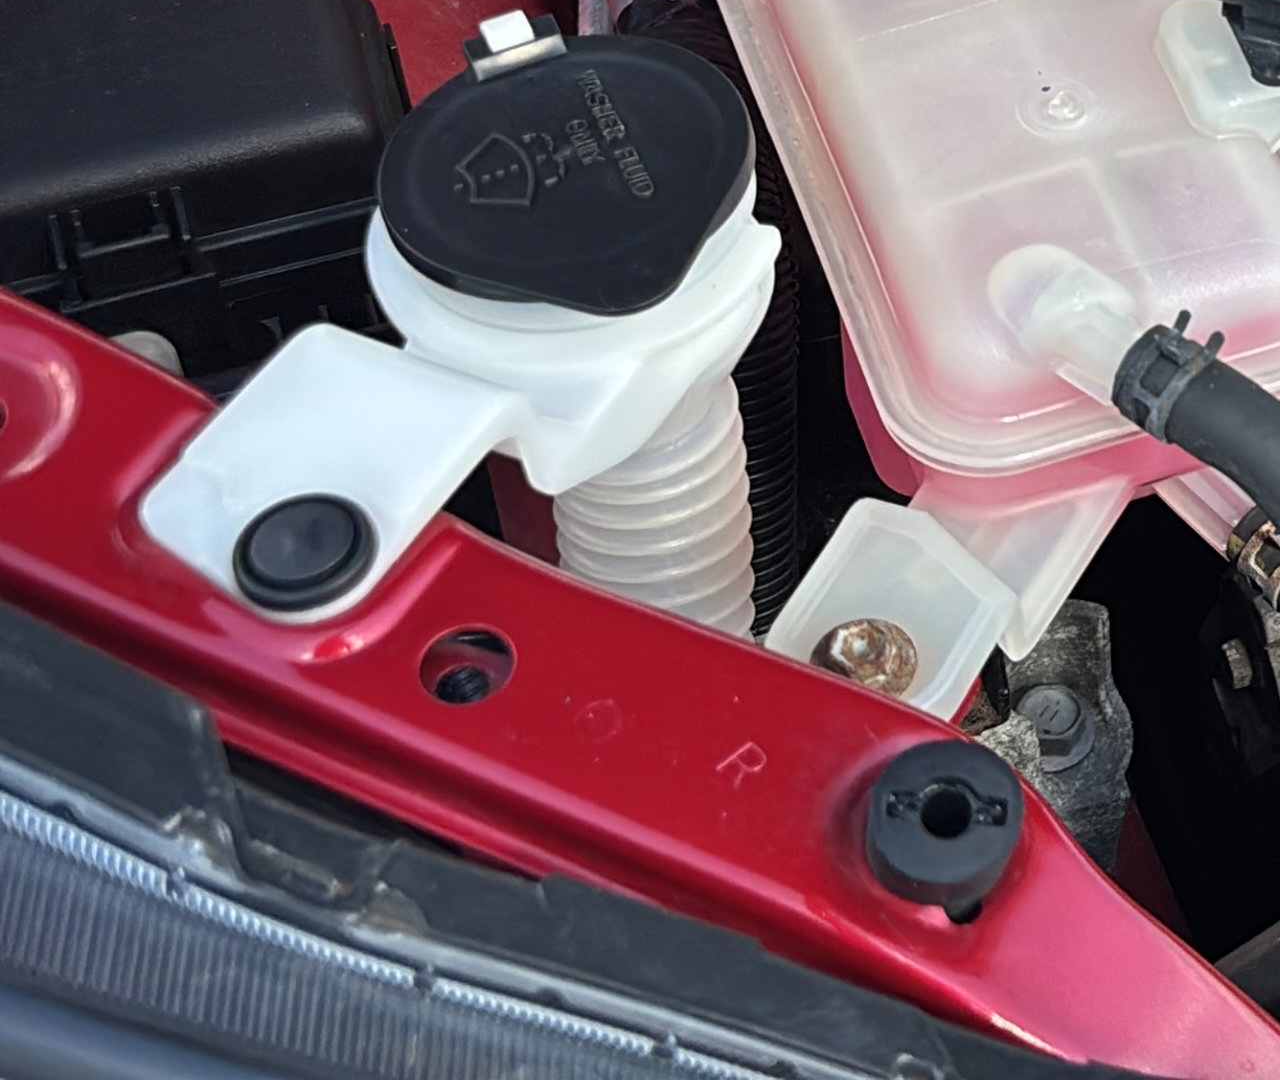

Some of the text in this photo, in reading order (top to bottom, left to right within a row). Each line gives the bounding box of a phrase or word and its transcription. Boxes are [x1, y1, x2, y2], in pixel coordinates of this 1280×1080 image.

[565, 119, 606, 166] ONLY
[576, 69, 655, 200] WASHER FLUID
[715, 741, 768, 790] R
